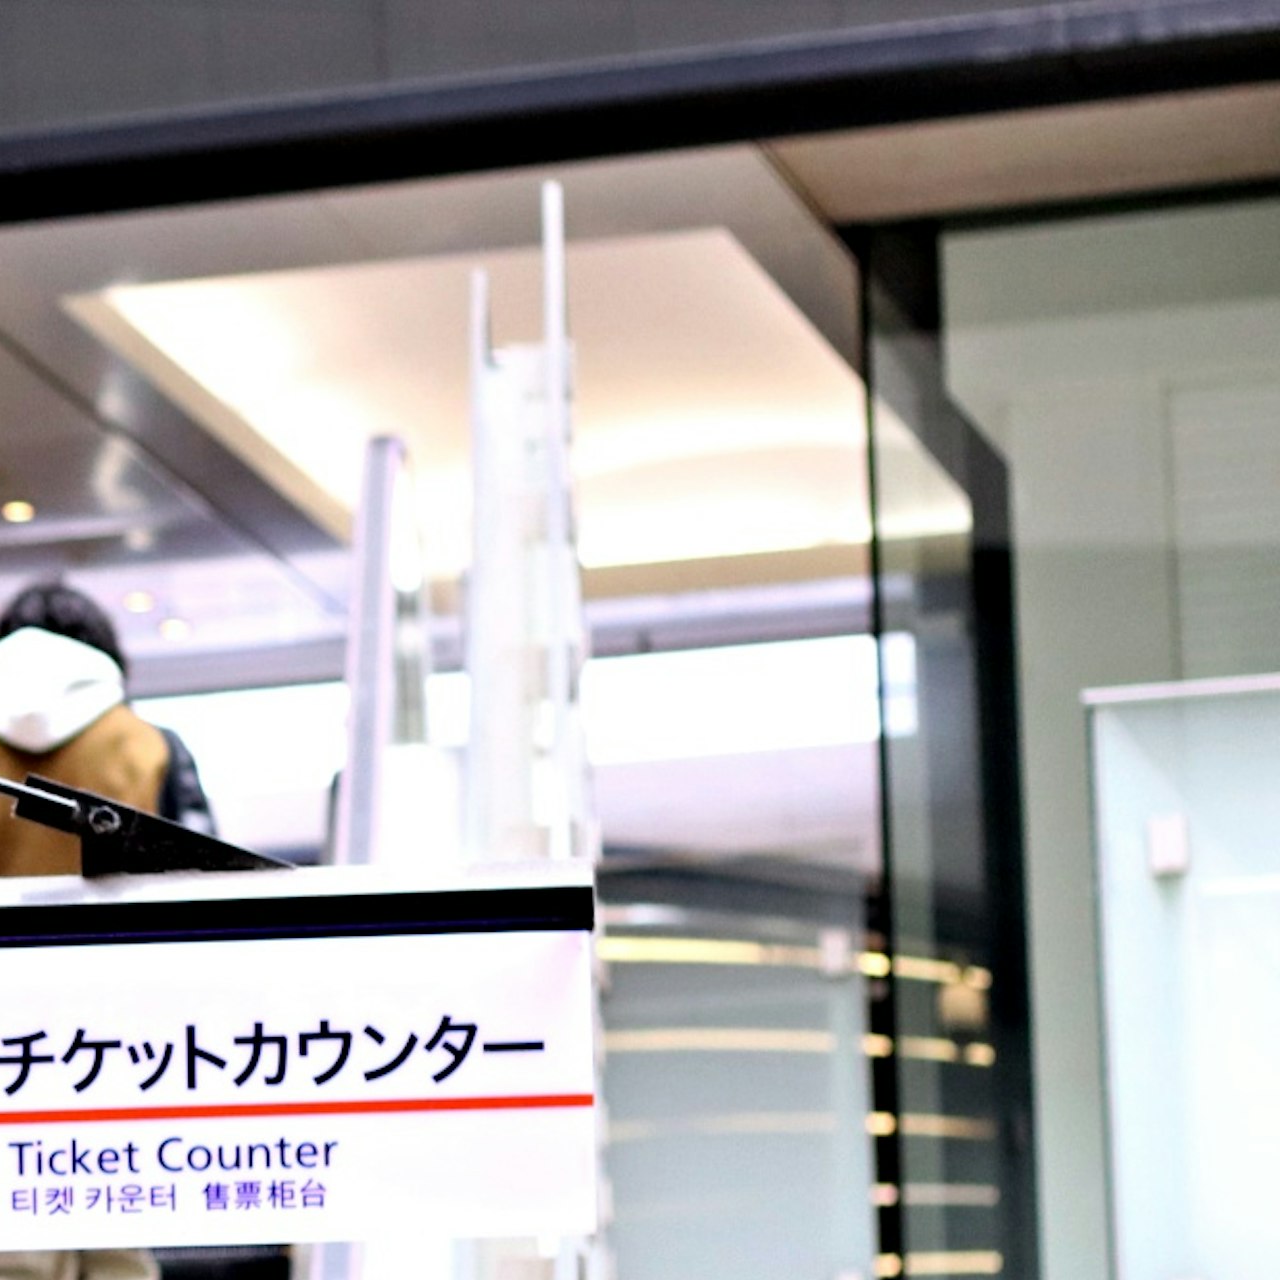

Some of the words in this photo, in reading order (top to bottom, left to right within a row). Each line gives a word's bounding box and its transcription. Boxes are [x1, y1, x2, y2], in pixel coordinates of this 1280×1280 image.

[9, 1139, 139, 1176] Ticket
[157, 1137, 337, 1172] Counter
[12, 1186, 73, 1215] 티켓
[86, 1184, 176, 1213] 카운터
[203, 1179, 325, 1210] 售票柜台
